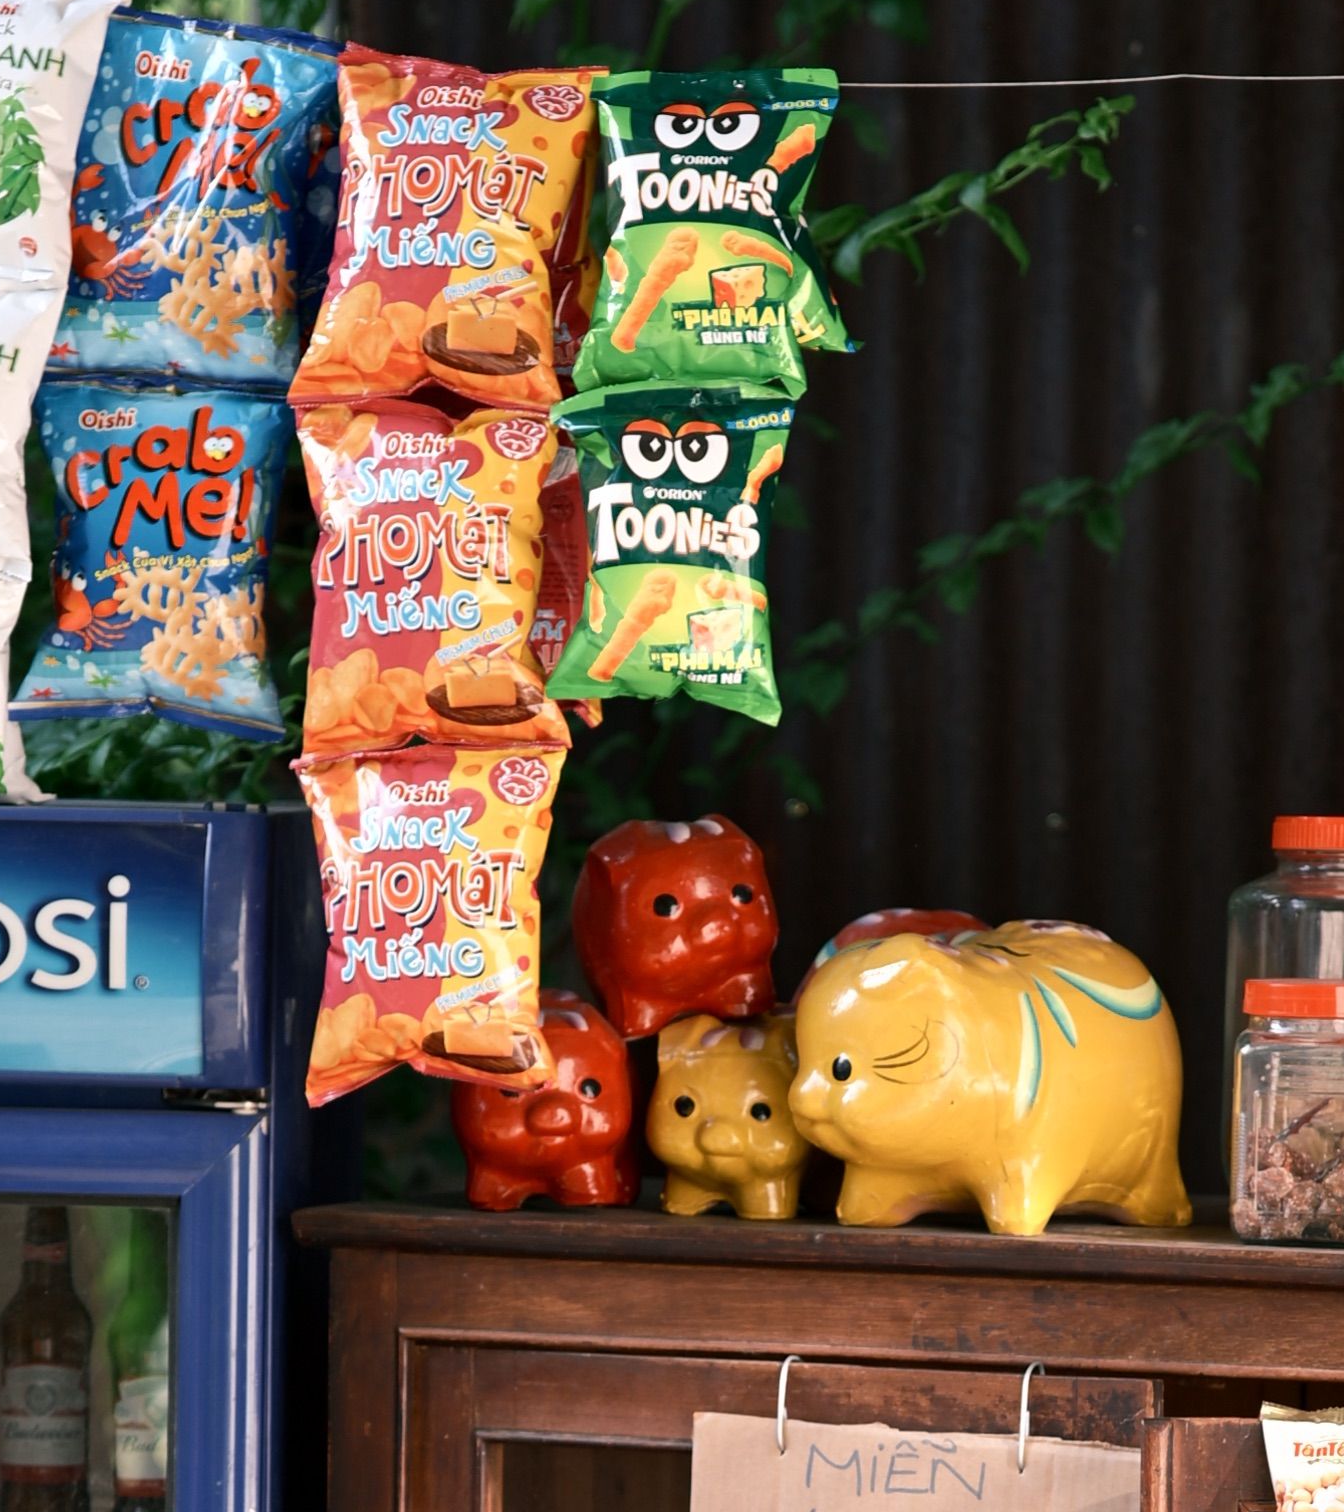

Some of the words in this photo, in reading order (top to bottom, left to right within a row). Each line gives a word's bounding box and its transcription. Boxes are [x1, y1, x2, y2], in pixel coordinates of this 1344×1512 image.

[418, 87, 484, 109] Oishi
[682, 154, 731, 165] ORION
[80, 409, 136, 429] Oishi
[67, 405, 246, 510] Crab
[656, 488, 704, 501] ORION
[113, 468, 255, 548] Me!
